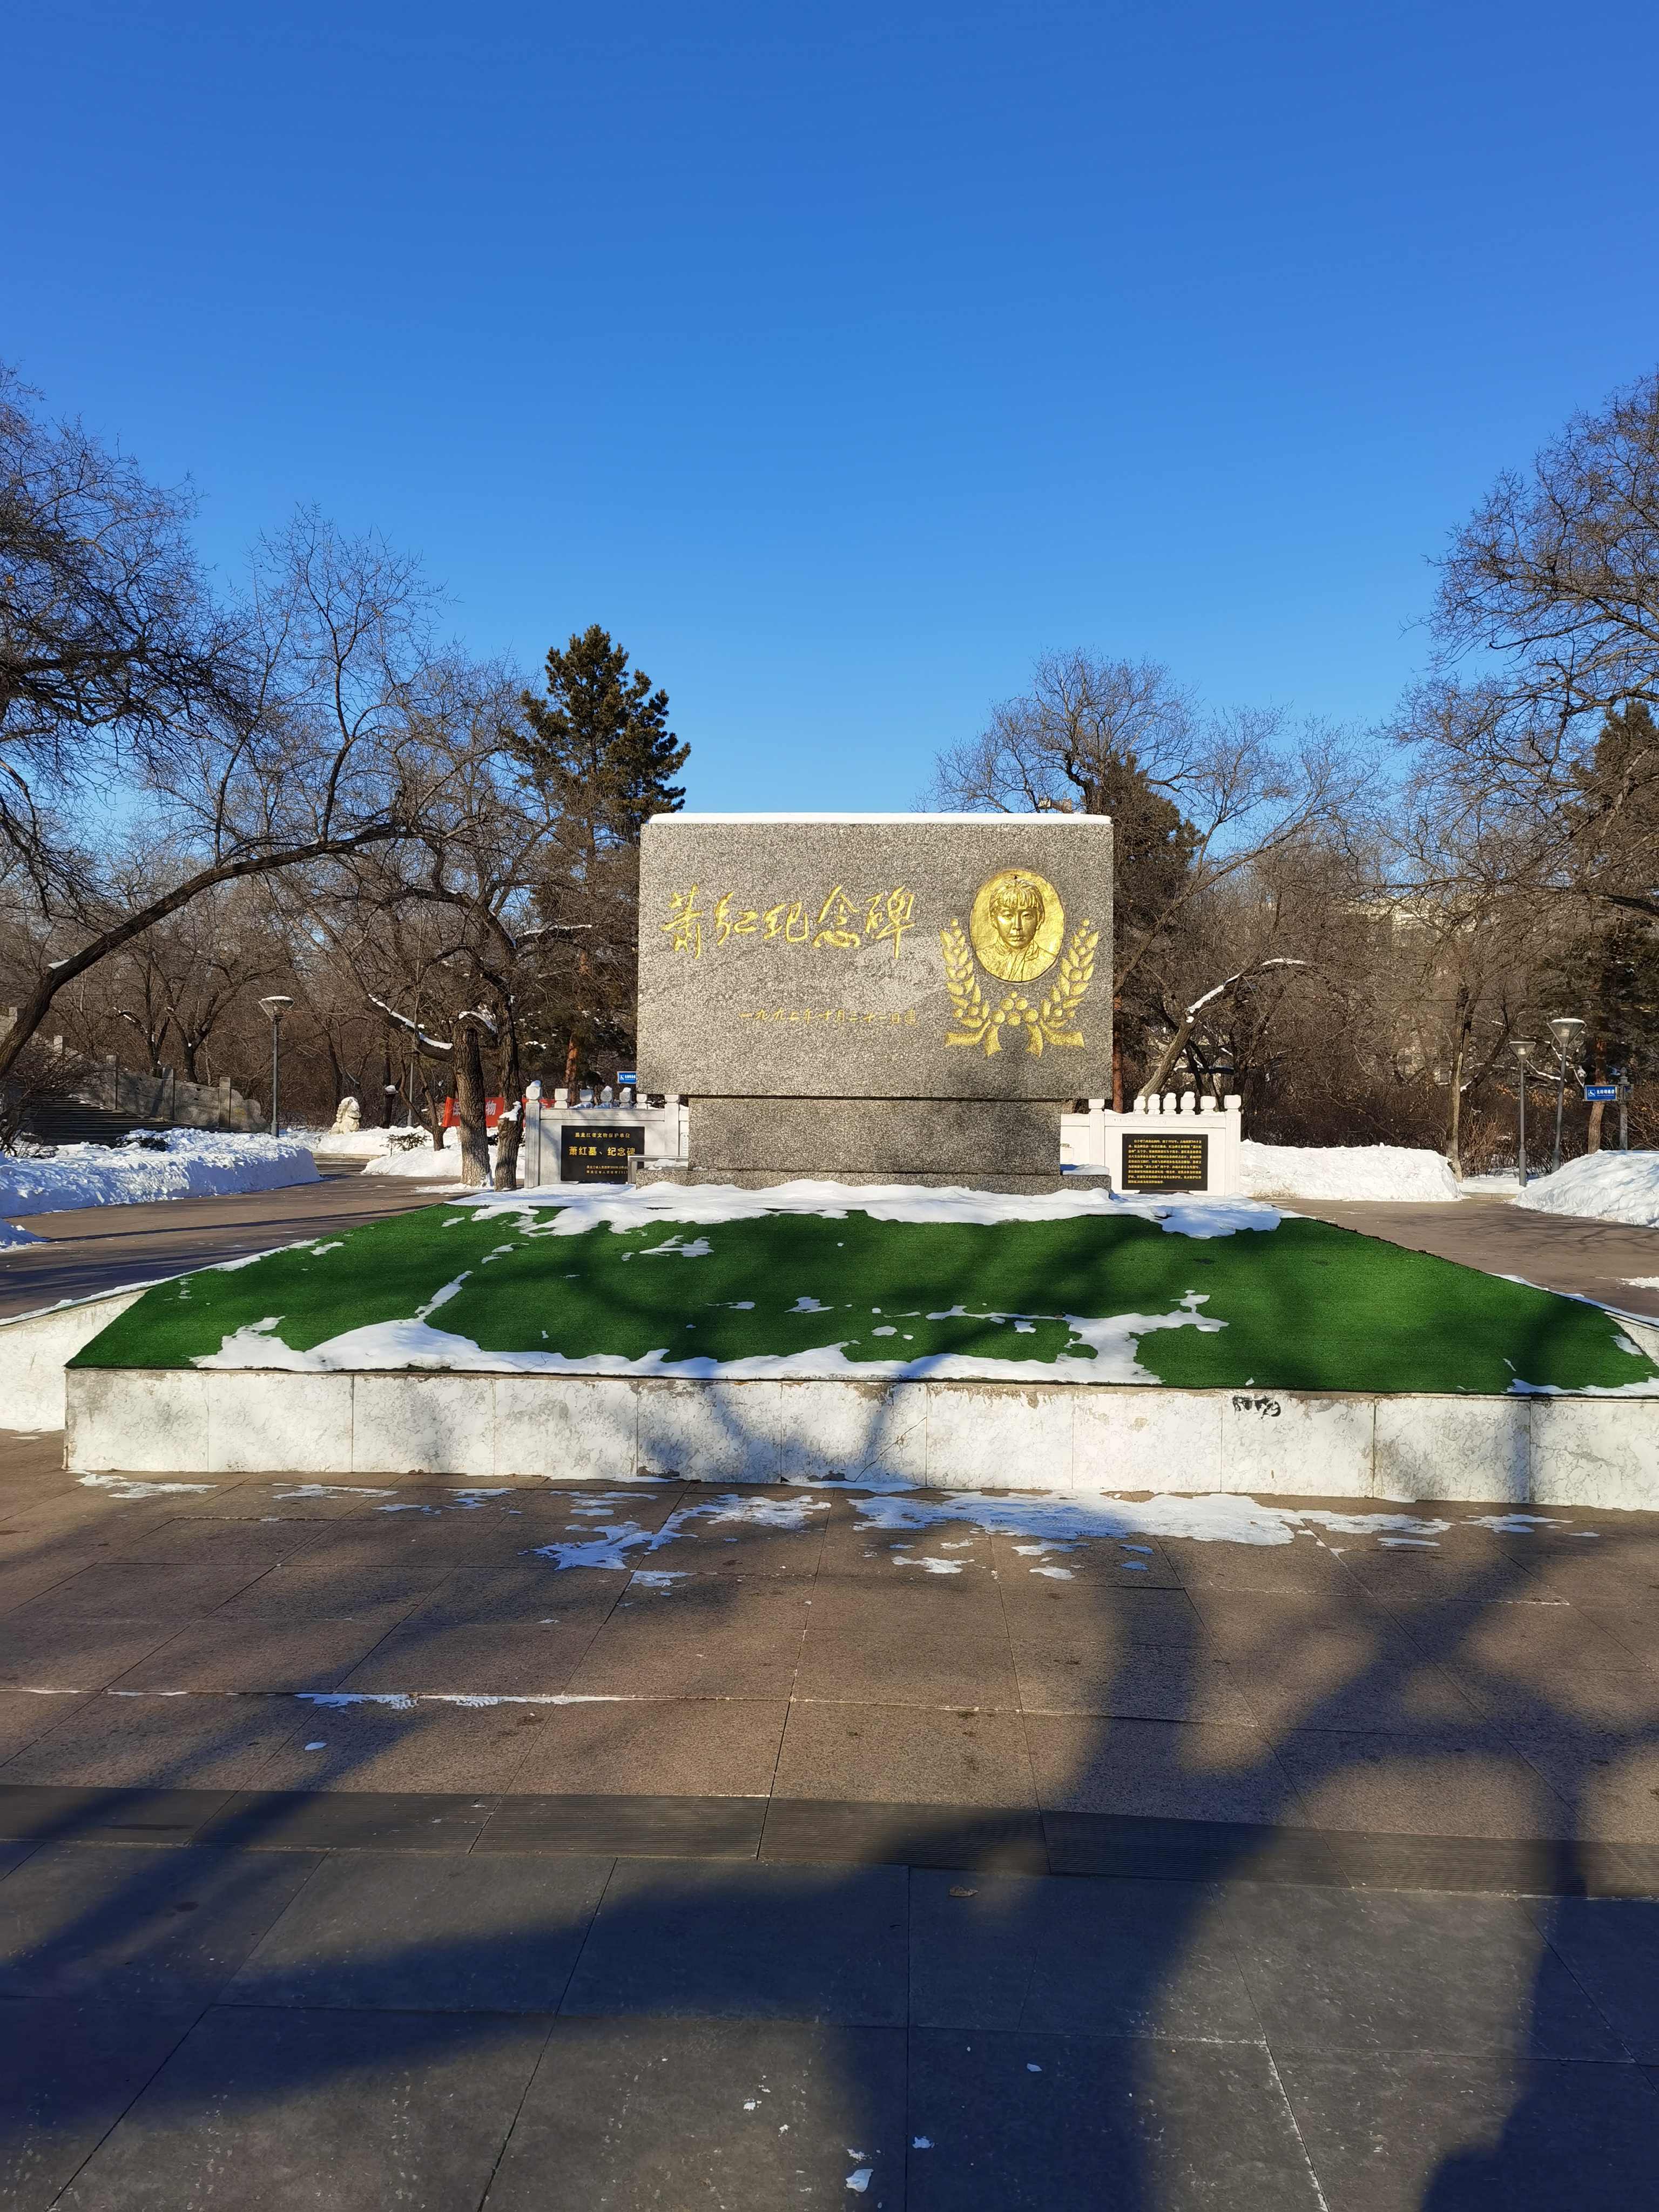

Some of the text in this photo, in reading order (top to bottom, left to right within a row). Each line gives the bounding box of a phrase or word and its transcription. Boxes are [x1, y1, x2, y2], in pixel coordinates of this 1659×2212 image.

[569, 1146, 636, 1156] 萧红墓、纪念碑
